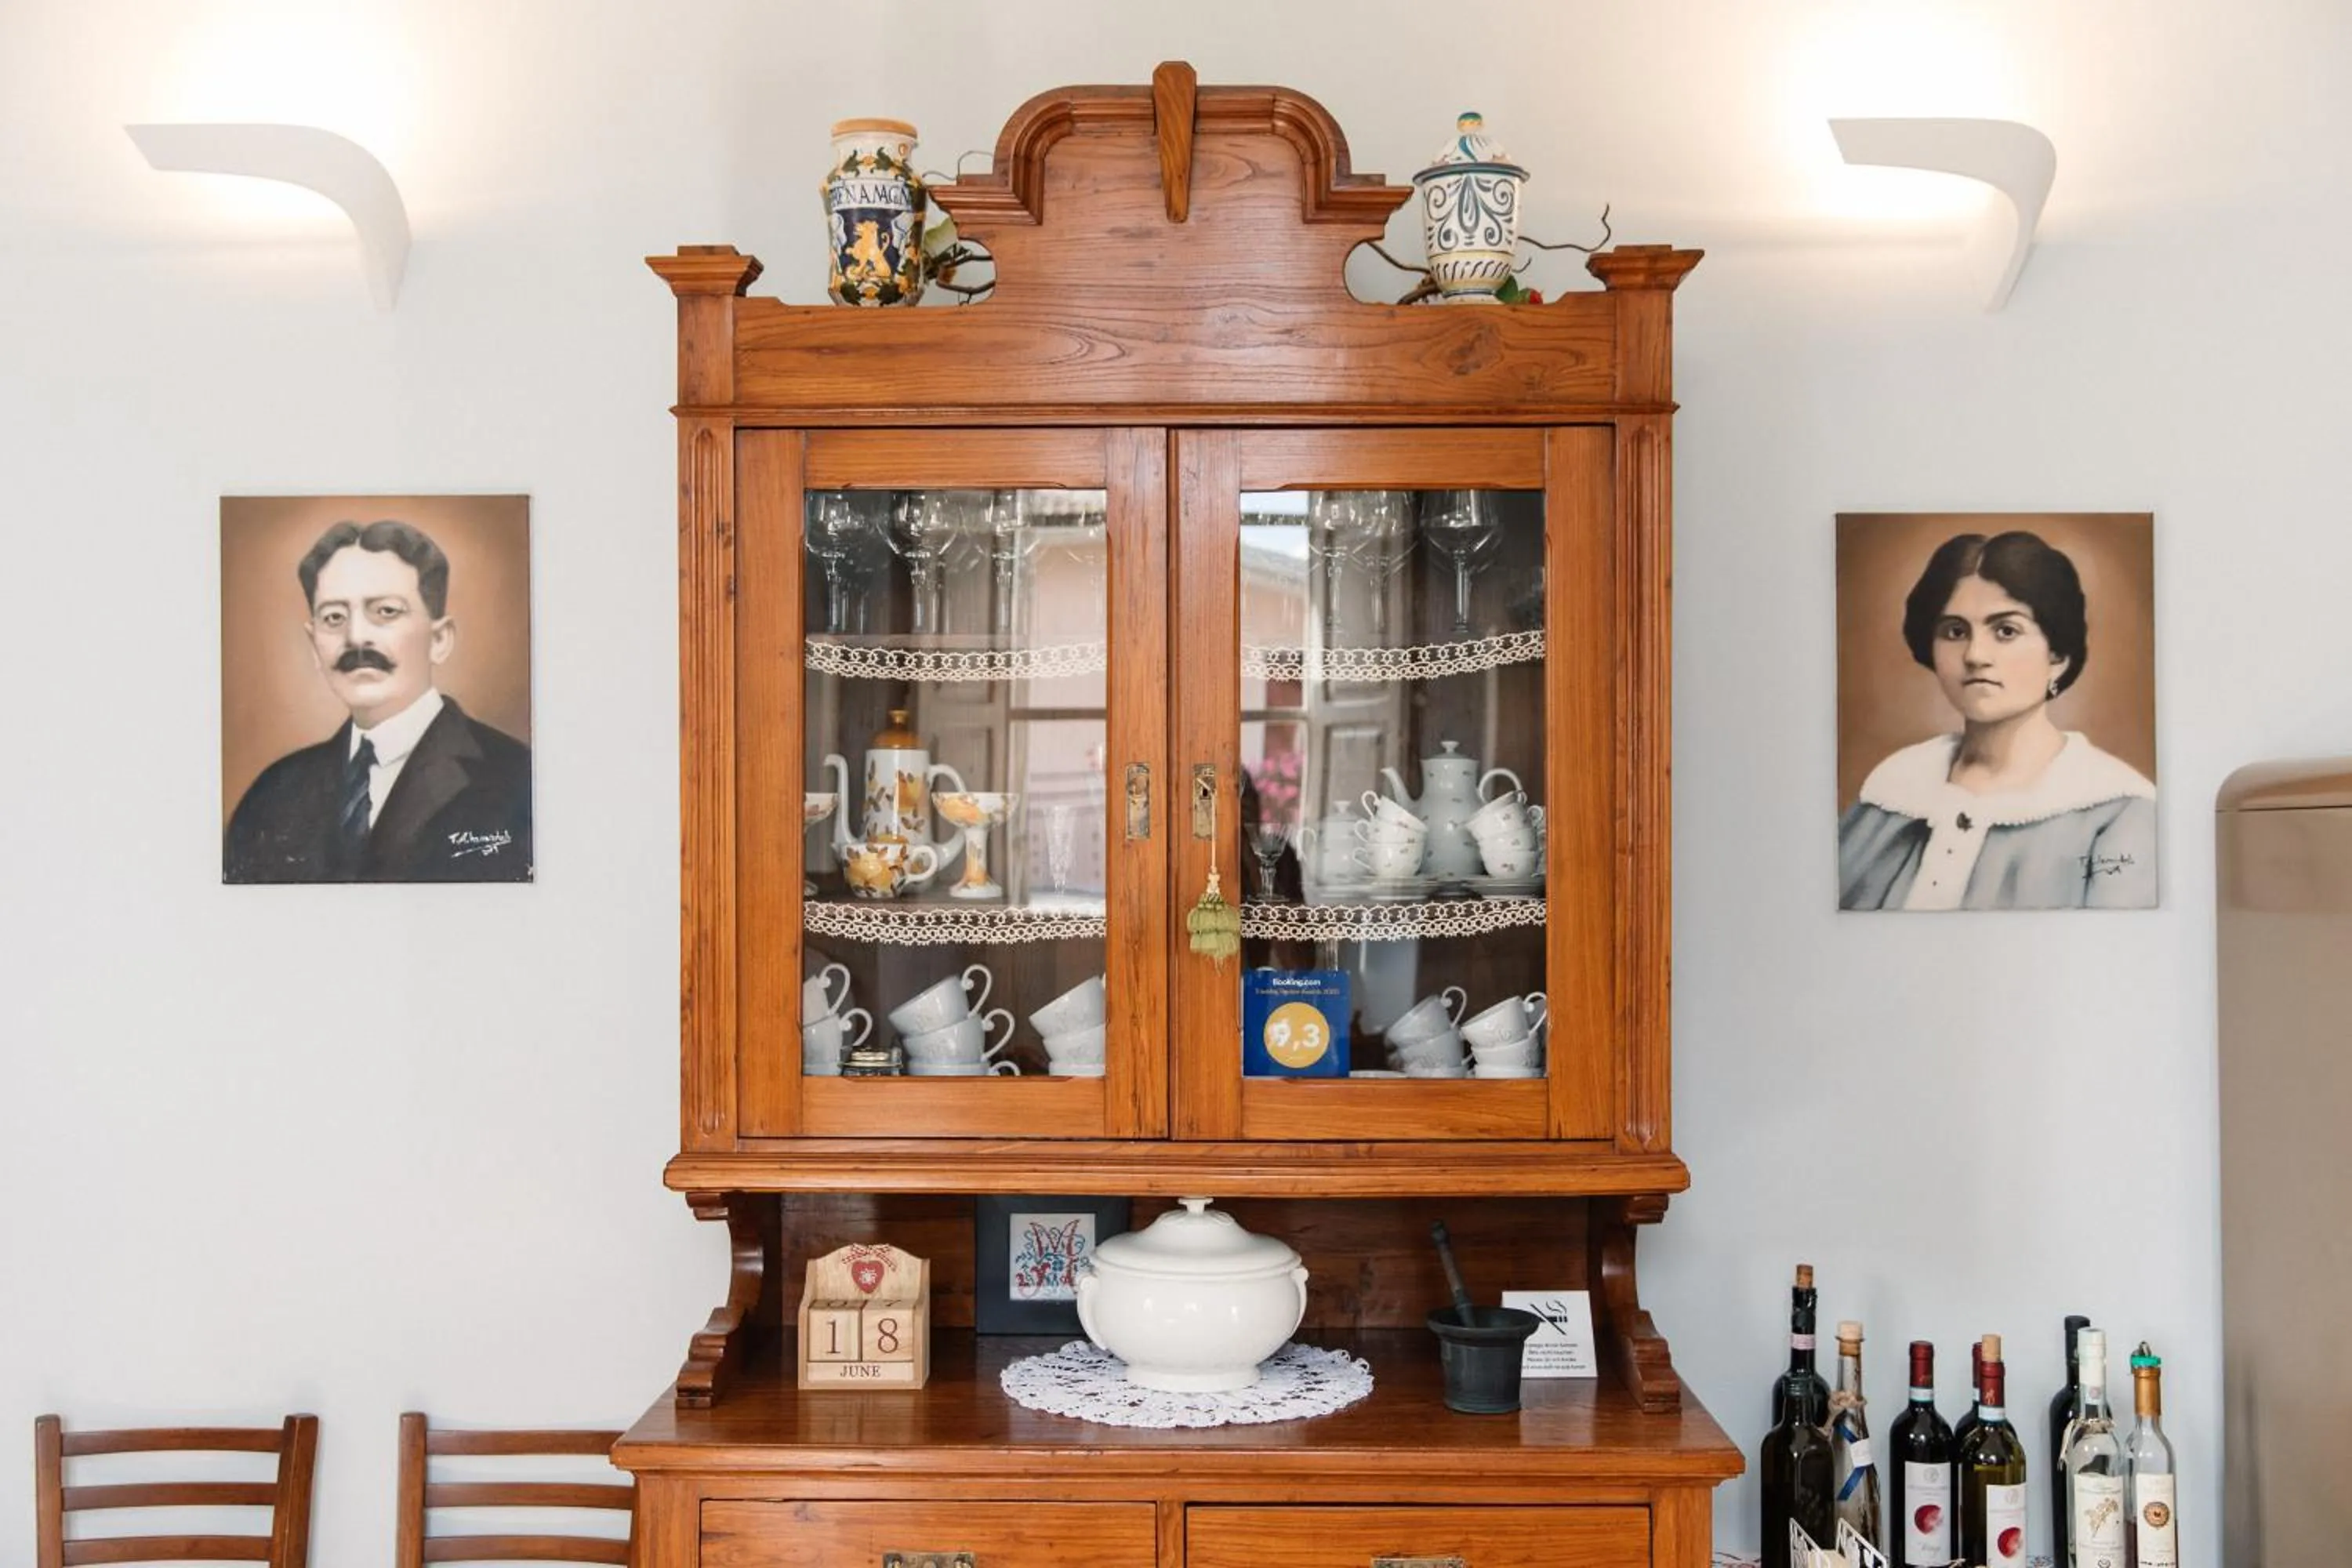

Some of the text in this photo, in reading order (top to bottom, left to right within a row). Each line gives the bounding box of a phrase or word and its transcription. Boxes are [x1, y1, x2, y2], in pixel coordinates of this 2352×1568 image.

[1272, 978, 1321, 987] Booking.com
[826, 1318, 898, 1354] 1 8
[840, 1365, 881, 1377] JUNE
